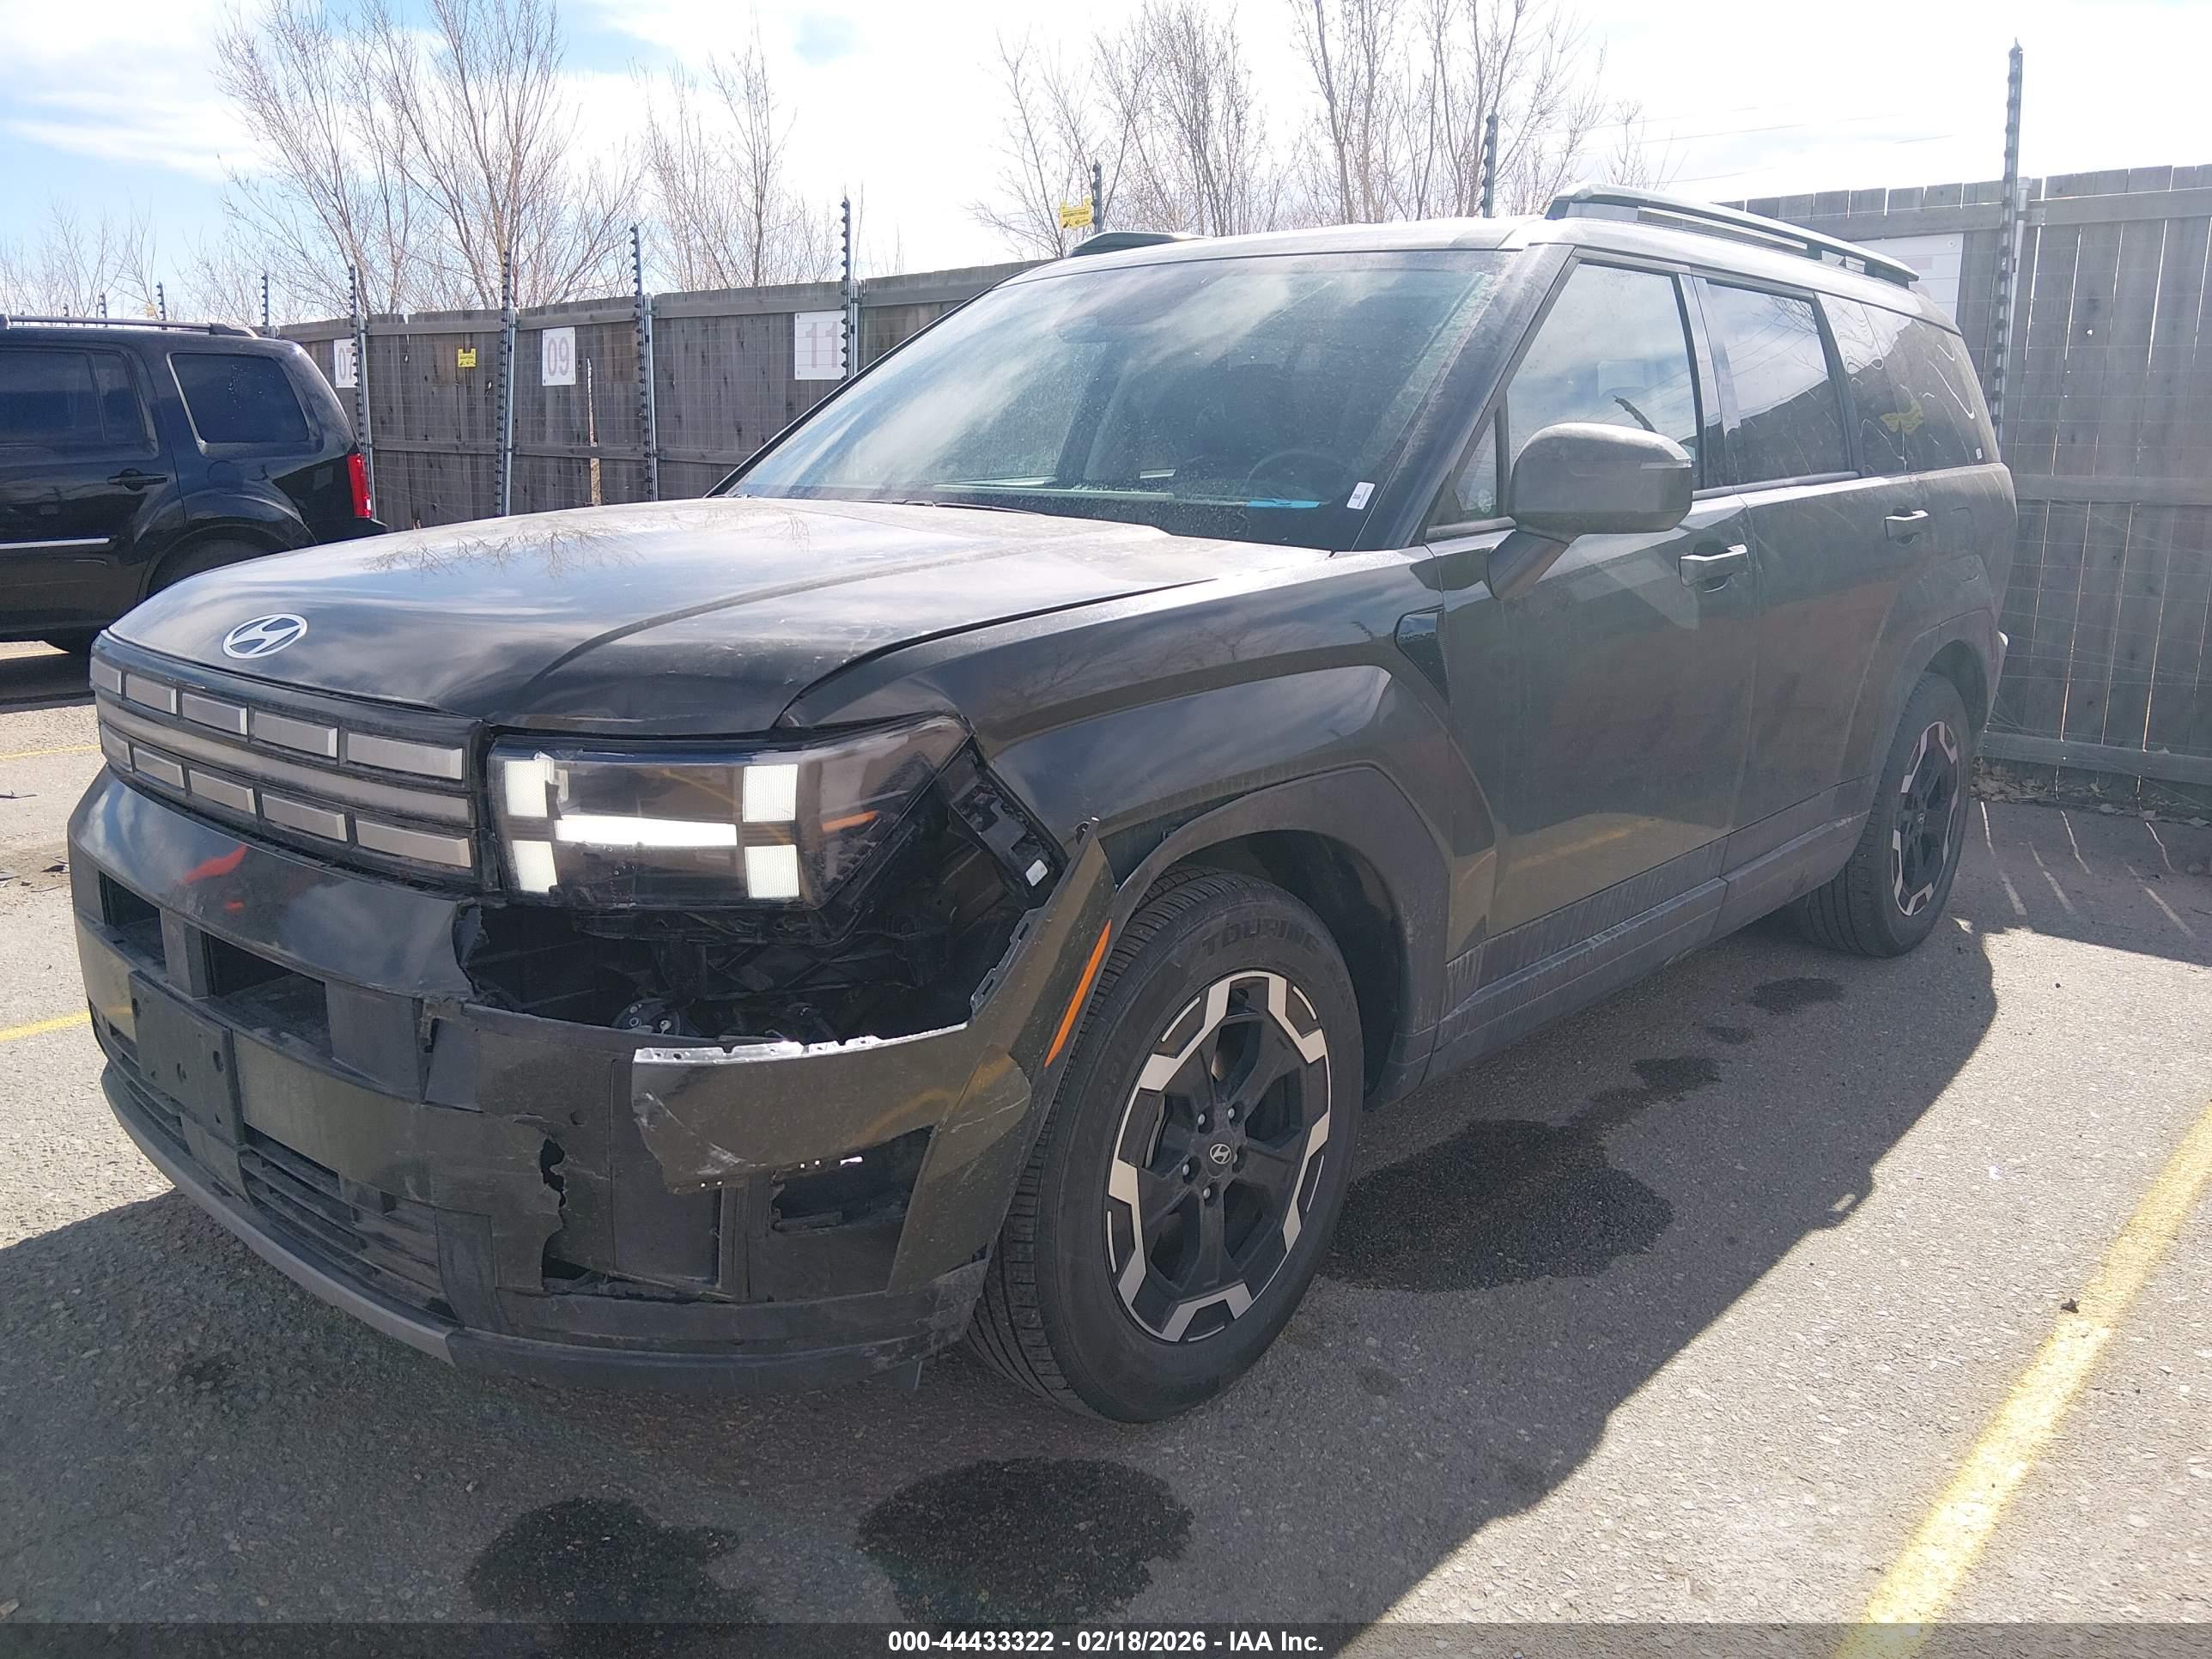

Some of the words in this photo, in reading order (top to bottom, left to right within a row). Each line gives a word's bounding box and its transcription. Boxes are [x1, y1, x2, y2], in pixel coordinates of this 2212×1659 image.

[547, 337, 570, 377] 09
[805, 321, 838, 368] 11
[1201, 919, 1321, 958] TOURING
